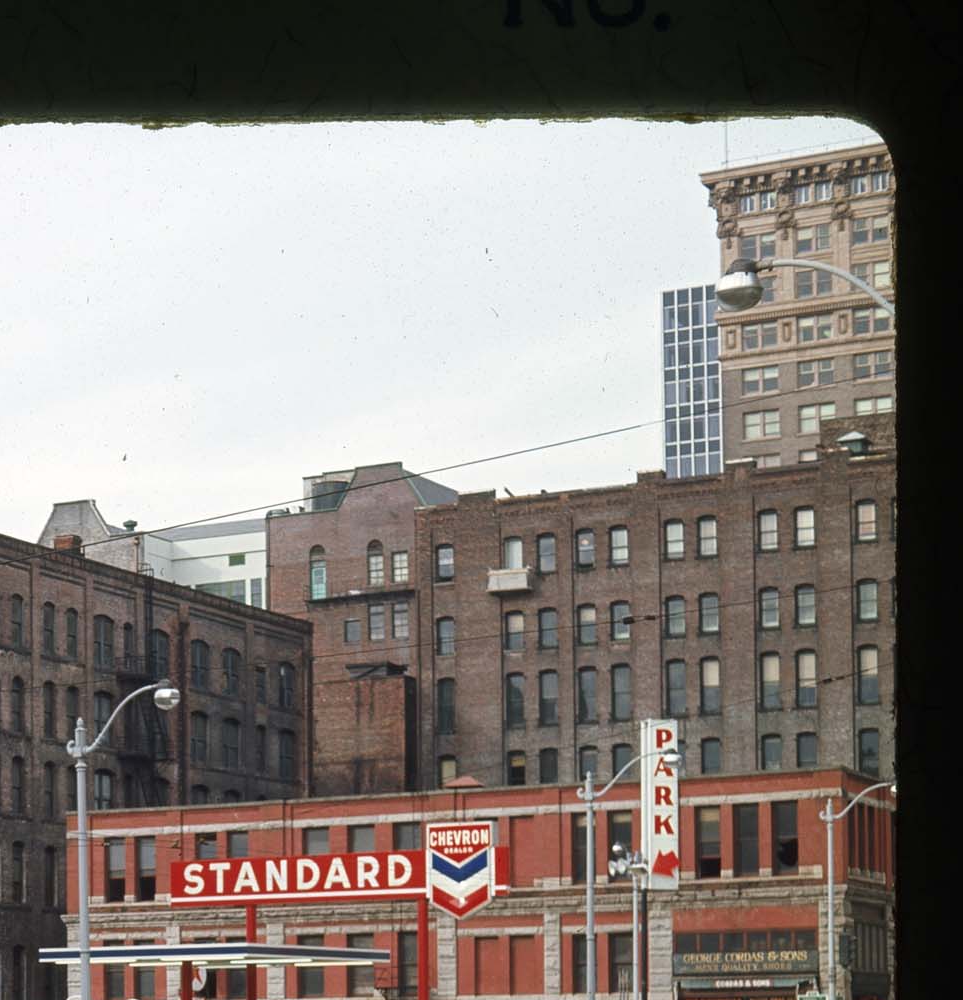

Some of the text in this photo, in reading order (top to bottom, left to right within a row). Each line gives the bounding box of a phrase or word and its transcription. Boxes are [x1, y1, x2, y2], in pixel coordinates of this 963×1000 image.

[654, 729, 674, 835] PARK
[430, 829, 489, 847] CHEVRON
[183, 854, 413, 896] STANDARD
[683, 950, 808, 963] GEORGE CORDAS & SONS
